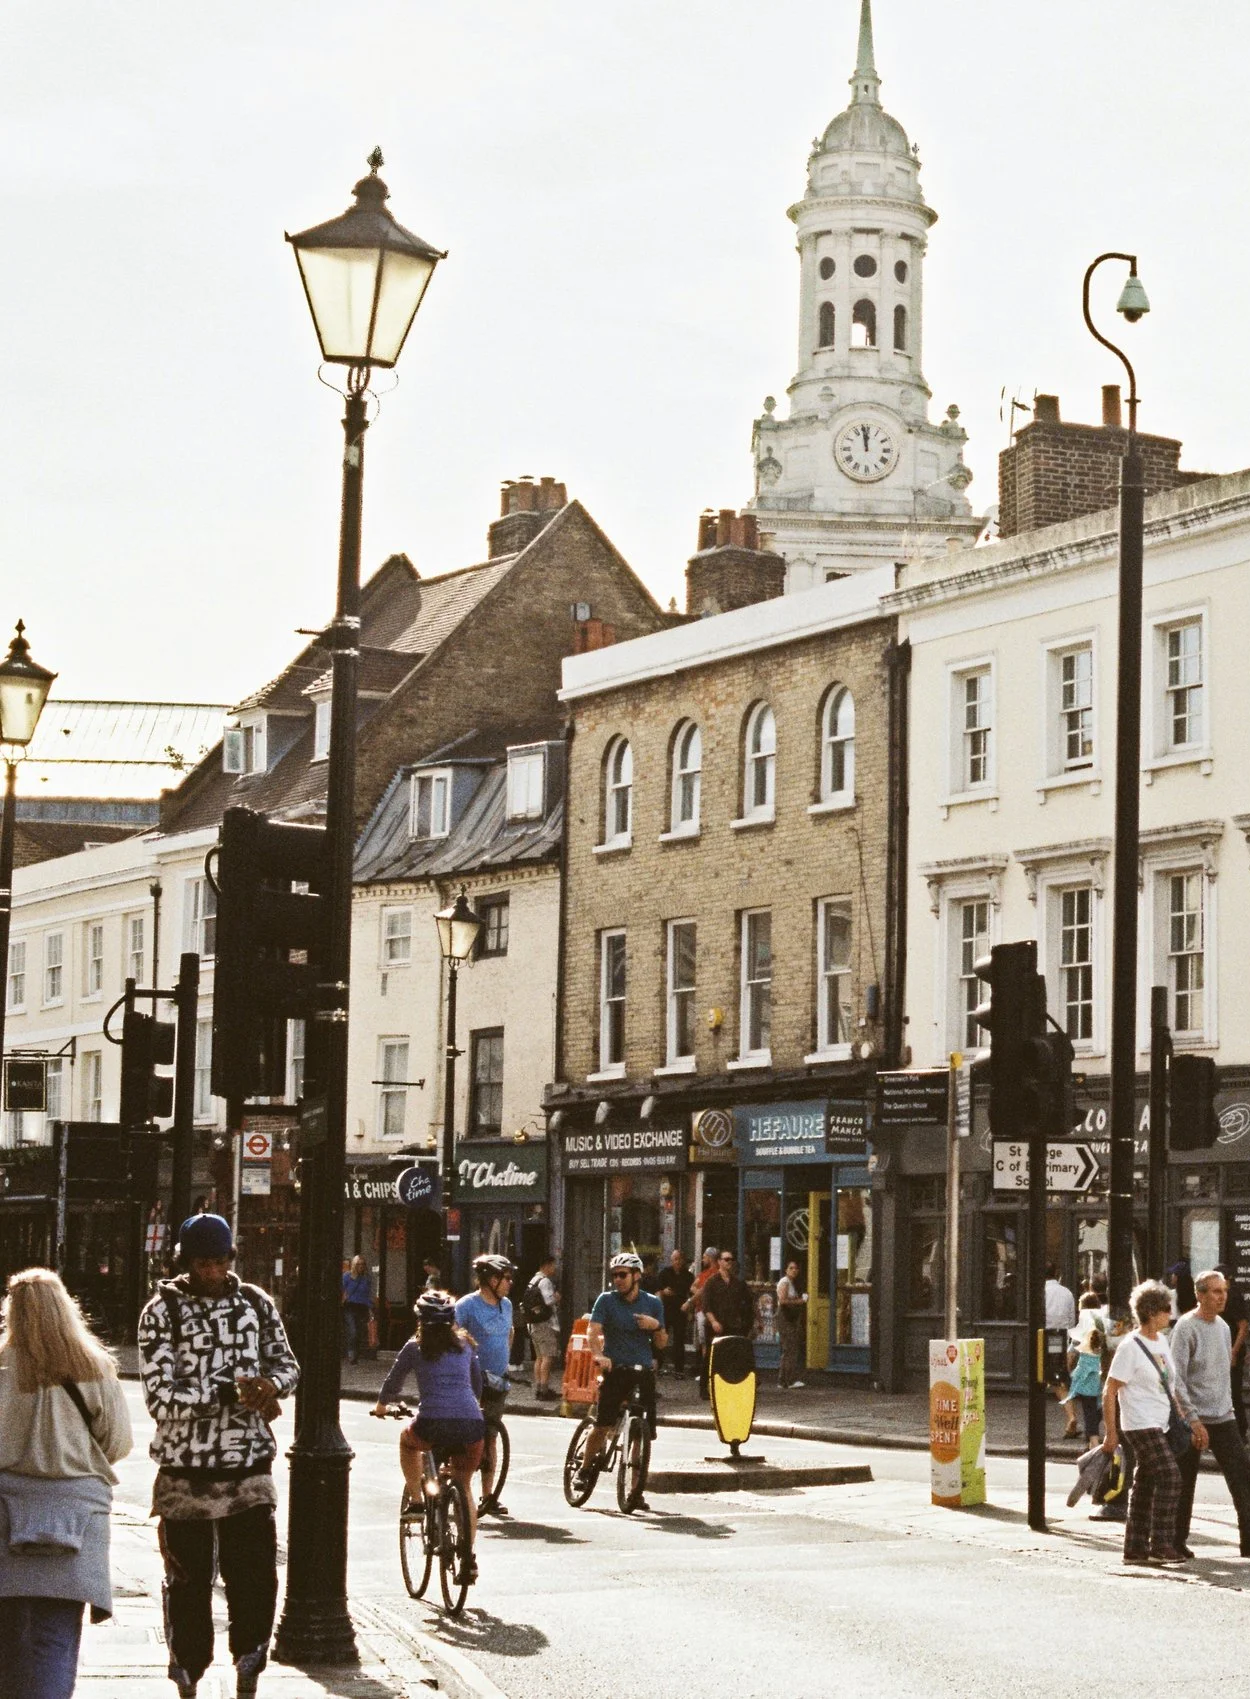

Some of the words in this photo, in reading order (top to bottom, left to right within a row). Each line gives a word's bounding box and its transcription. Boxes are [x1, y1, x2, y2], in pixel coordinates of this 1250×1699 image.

[830, 1115, 864, 1125] FRANCO
[830, 1126, 862, 1136] MANCA
[565, 1136, 593, 1152] MUSIC
[595, 1135, 602, 1151] &
[604, 1133, 631, 1150] VIDEO
[633, 1129, 683, 1149] EXCHANGE
[1009, 1145, 1021, 1157] St
[569, 1159, 579, 1169] BUY
[591, 1157, 607, 1168] TRADE
[995, 1160, 1004, 1171] C
[1009, 1160, 1021, 1171] of
[1045, 1162, 1079, 1175] rimary
[473, 1161, 538, 1188] Chatime
[1015, 1175, 1053, 1187] Scl
[410, 1175, 431, 1189] Cha
[353, 1182, 361, 1199] &
[364, 1182, 399, 1199] CHIPS
[405, 1184, 432, 1201] time
[936, 1399, 959, 1413] TIME
[934, 1415, 960, 1430] Well
[930, 1431, 959, 1445] SPENT
